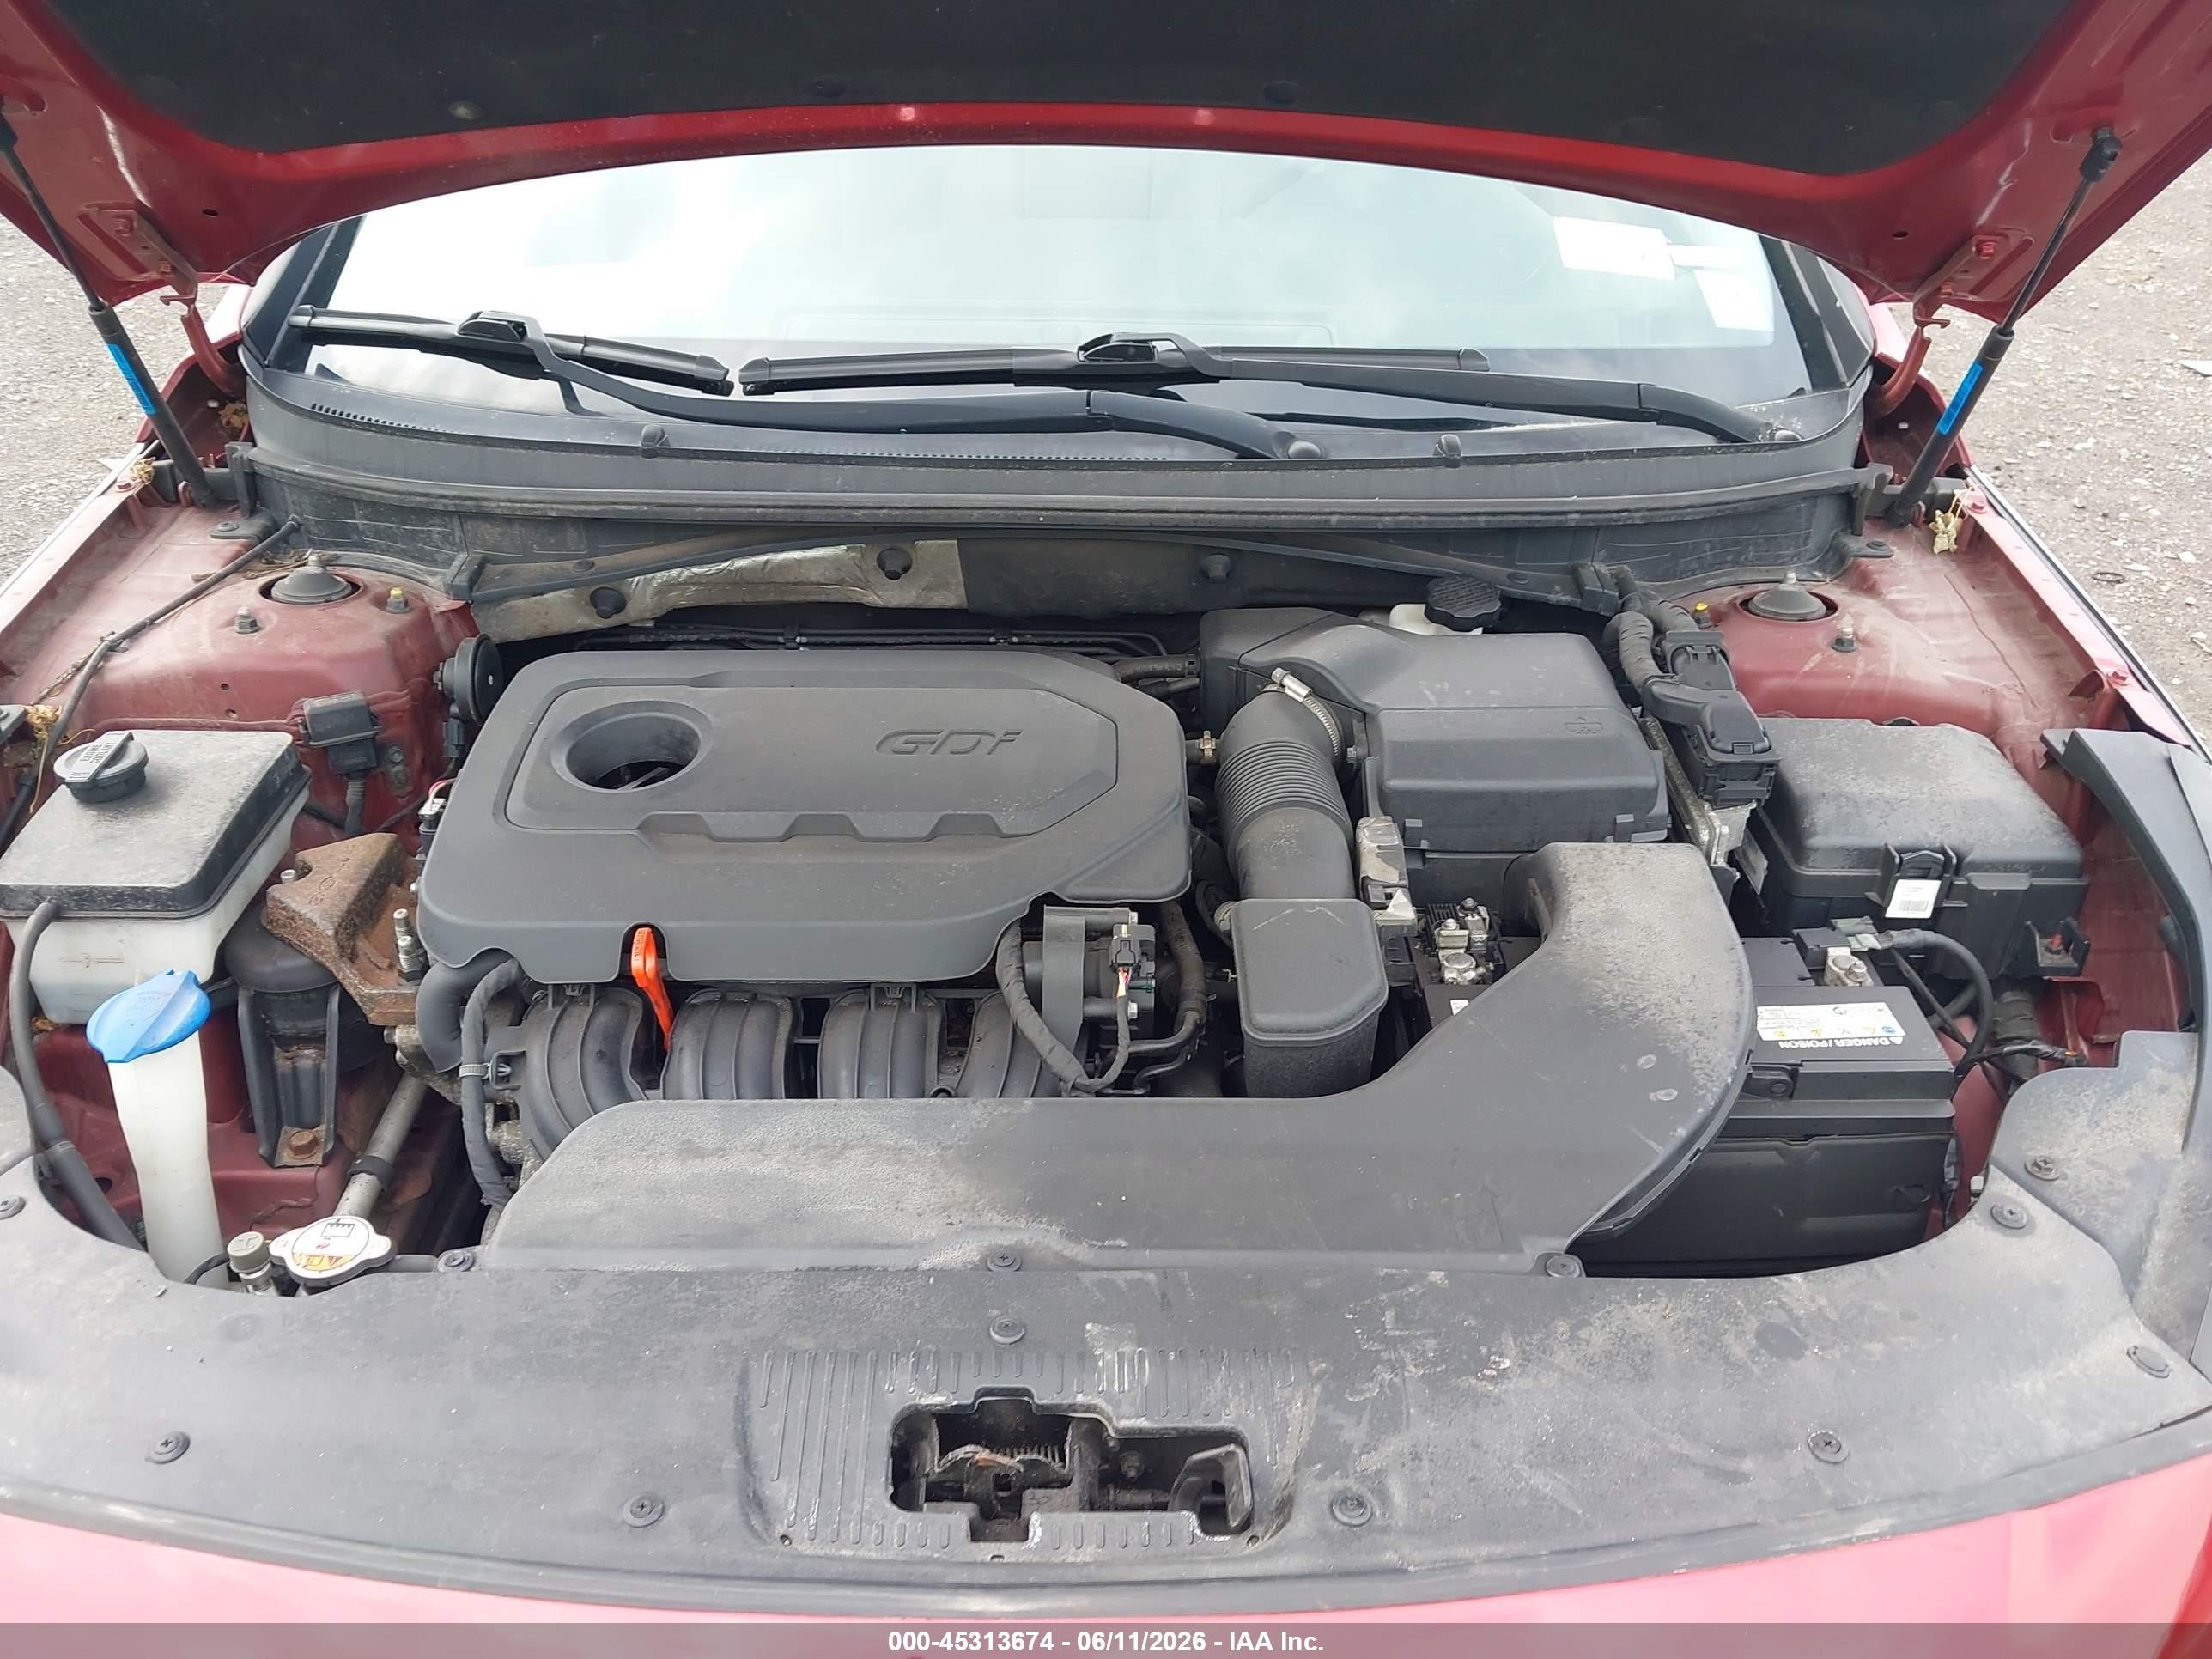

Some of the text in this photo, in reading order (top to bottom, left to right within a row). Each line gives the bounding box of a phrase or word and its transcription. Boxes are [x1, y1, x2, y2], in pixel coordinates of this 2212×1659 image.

[80, 744, 103, 762] ENGINE
[89, 742, 117, 764] COOLANT
[1778, 1039, 1829, 1048] POISON
[1834, 1036, 1890, 1048] DANGER
